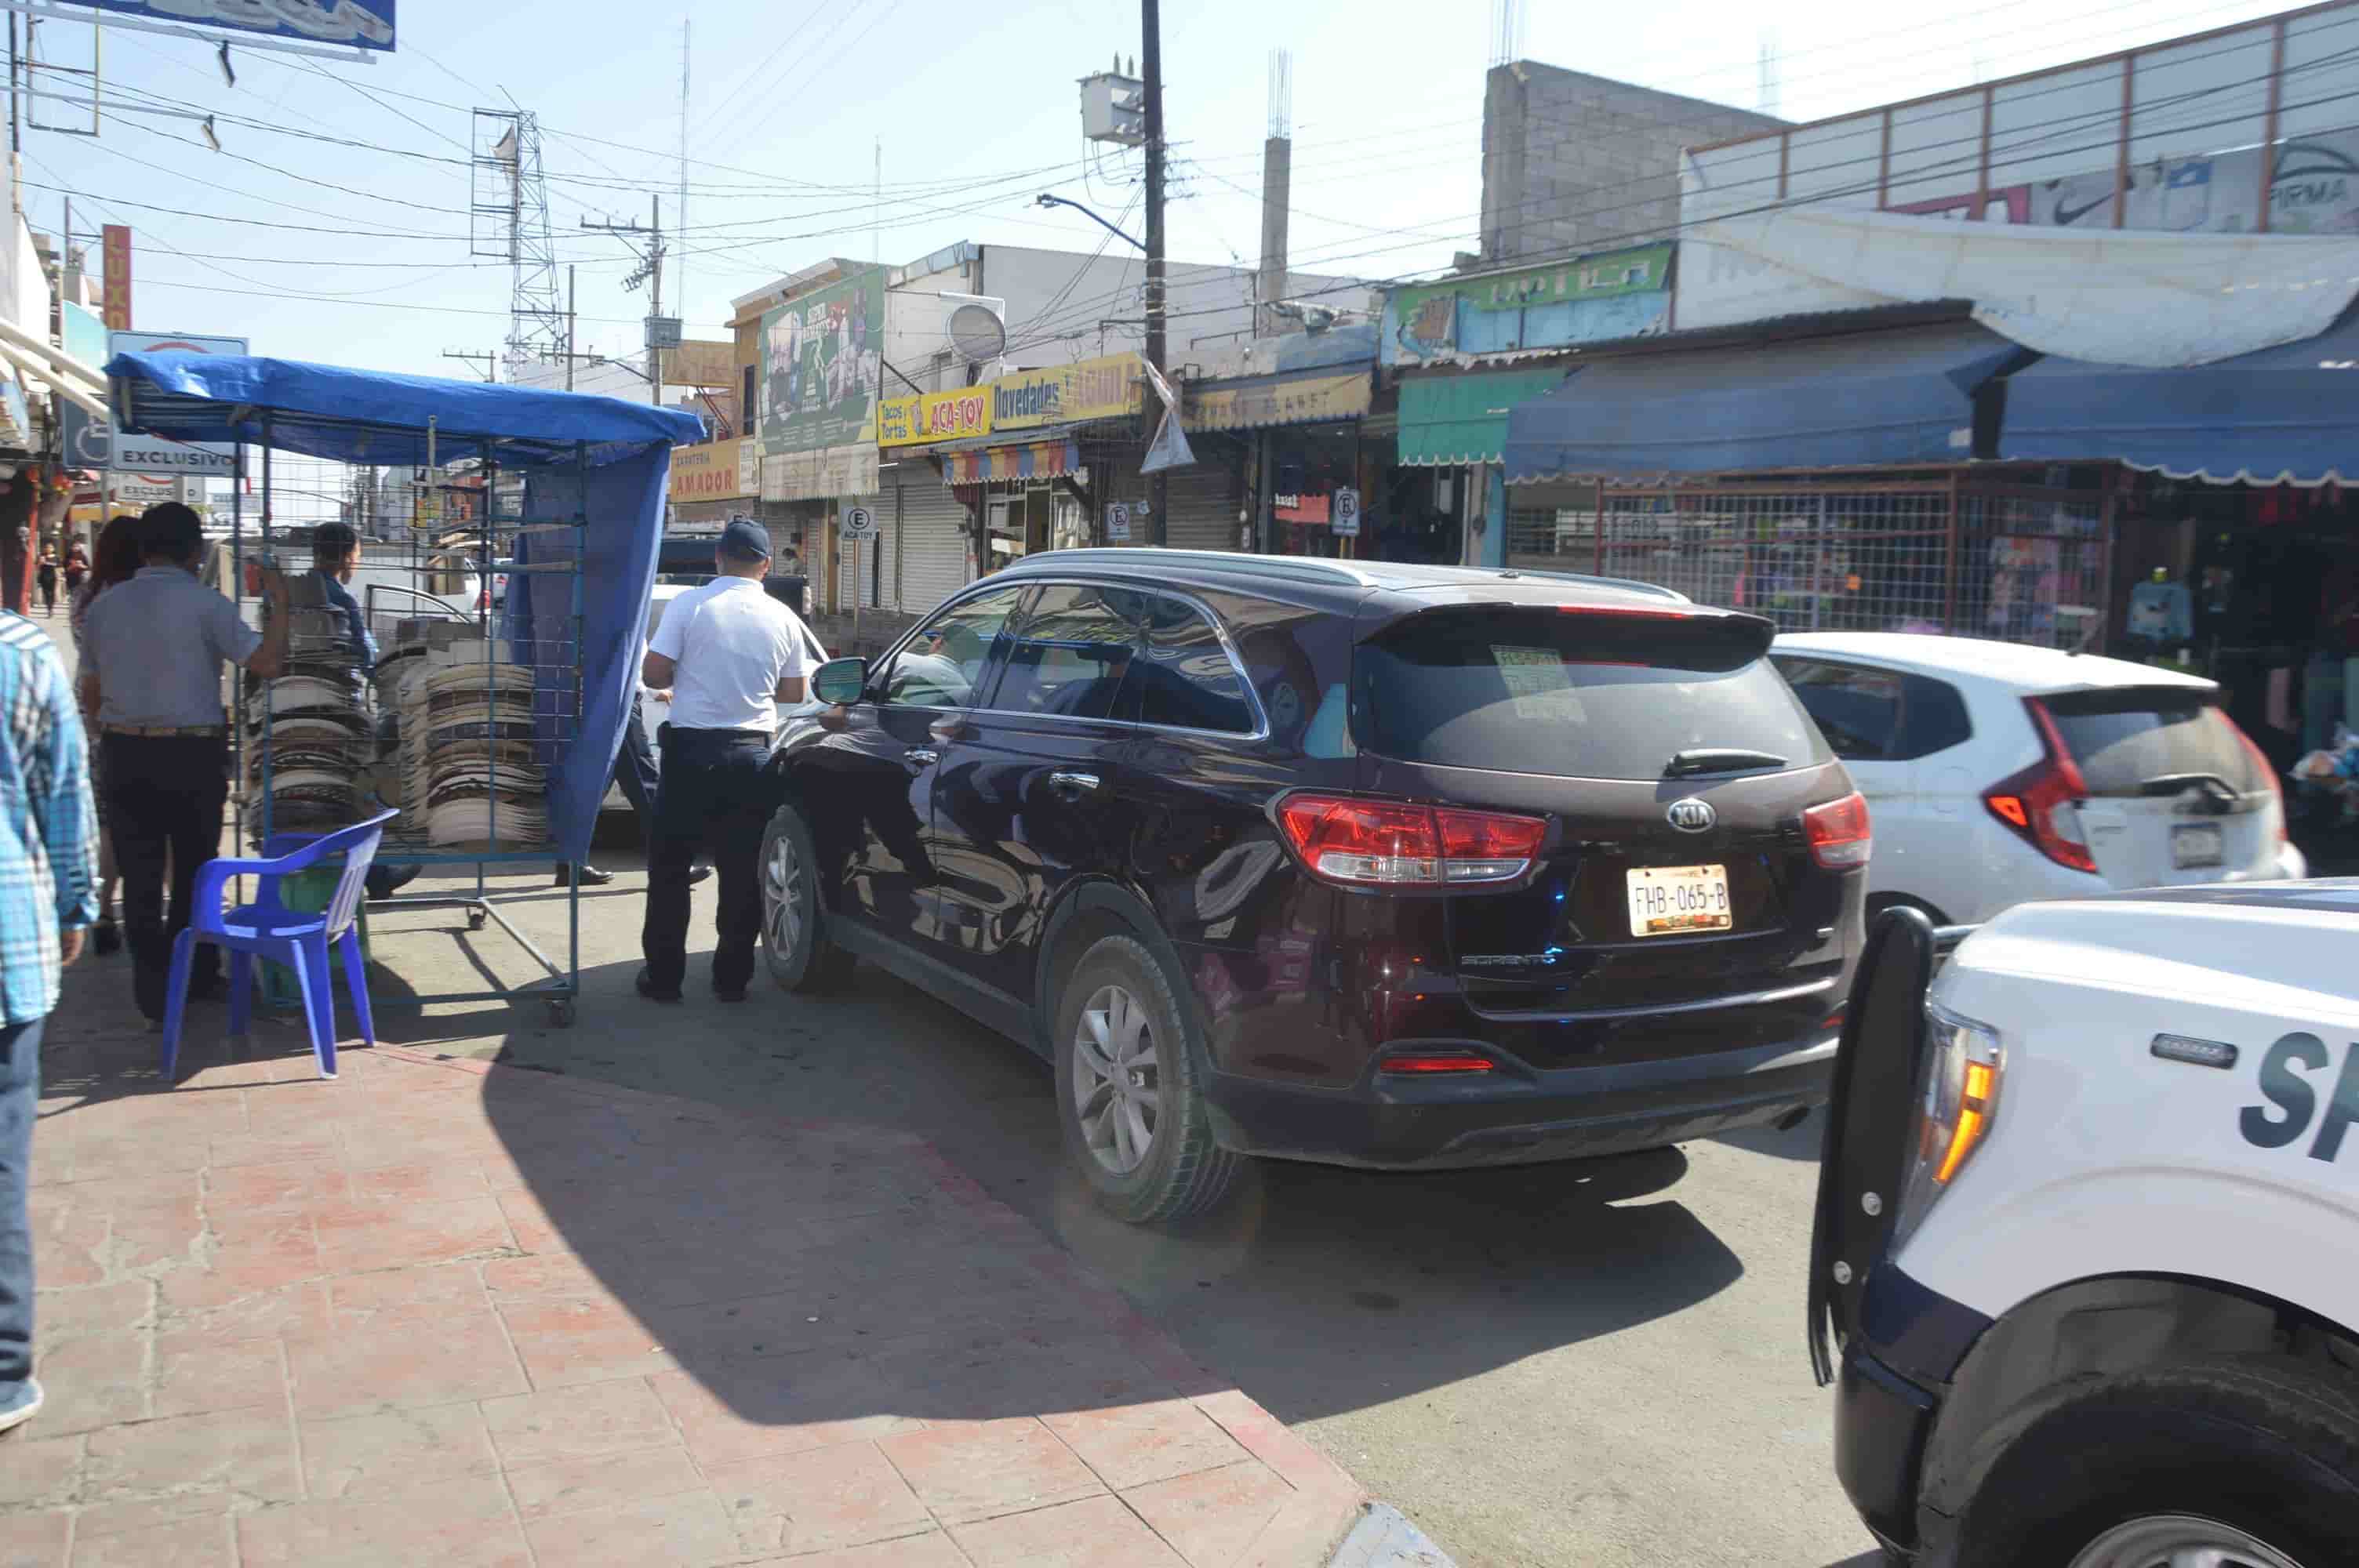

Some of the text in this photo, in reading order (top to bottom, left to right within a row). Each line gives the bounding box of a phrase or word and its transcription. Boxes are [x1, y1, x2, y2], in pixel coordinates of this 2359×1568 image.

[881, 404, 903, 420] Tacos
[881, 423, 907, 439] Tortas
[676, 468, 732, 495] AMADOR
[125, 485, 195, 497] EXCLUSO
[854, 513, 863, 525] E
[1676, 805, 1712, 825] KIA
[1636, 883, 1727, 915] FHB-065-B
